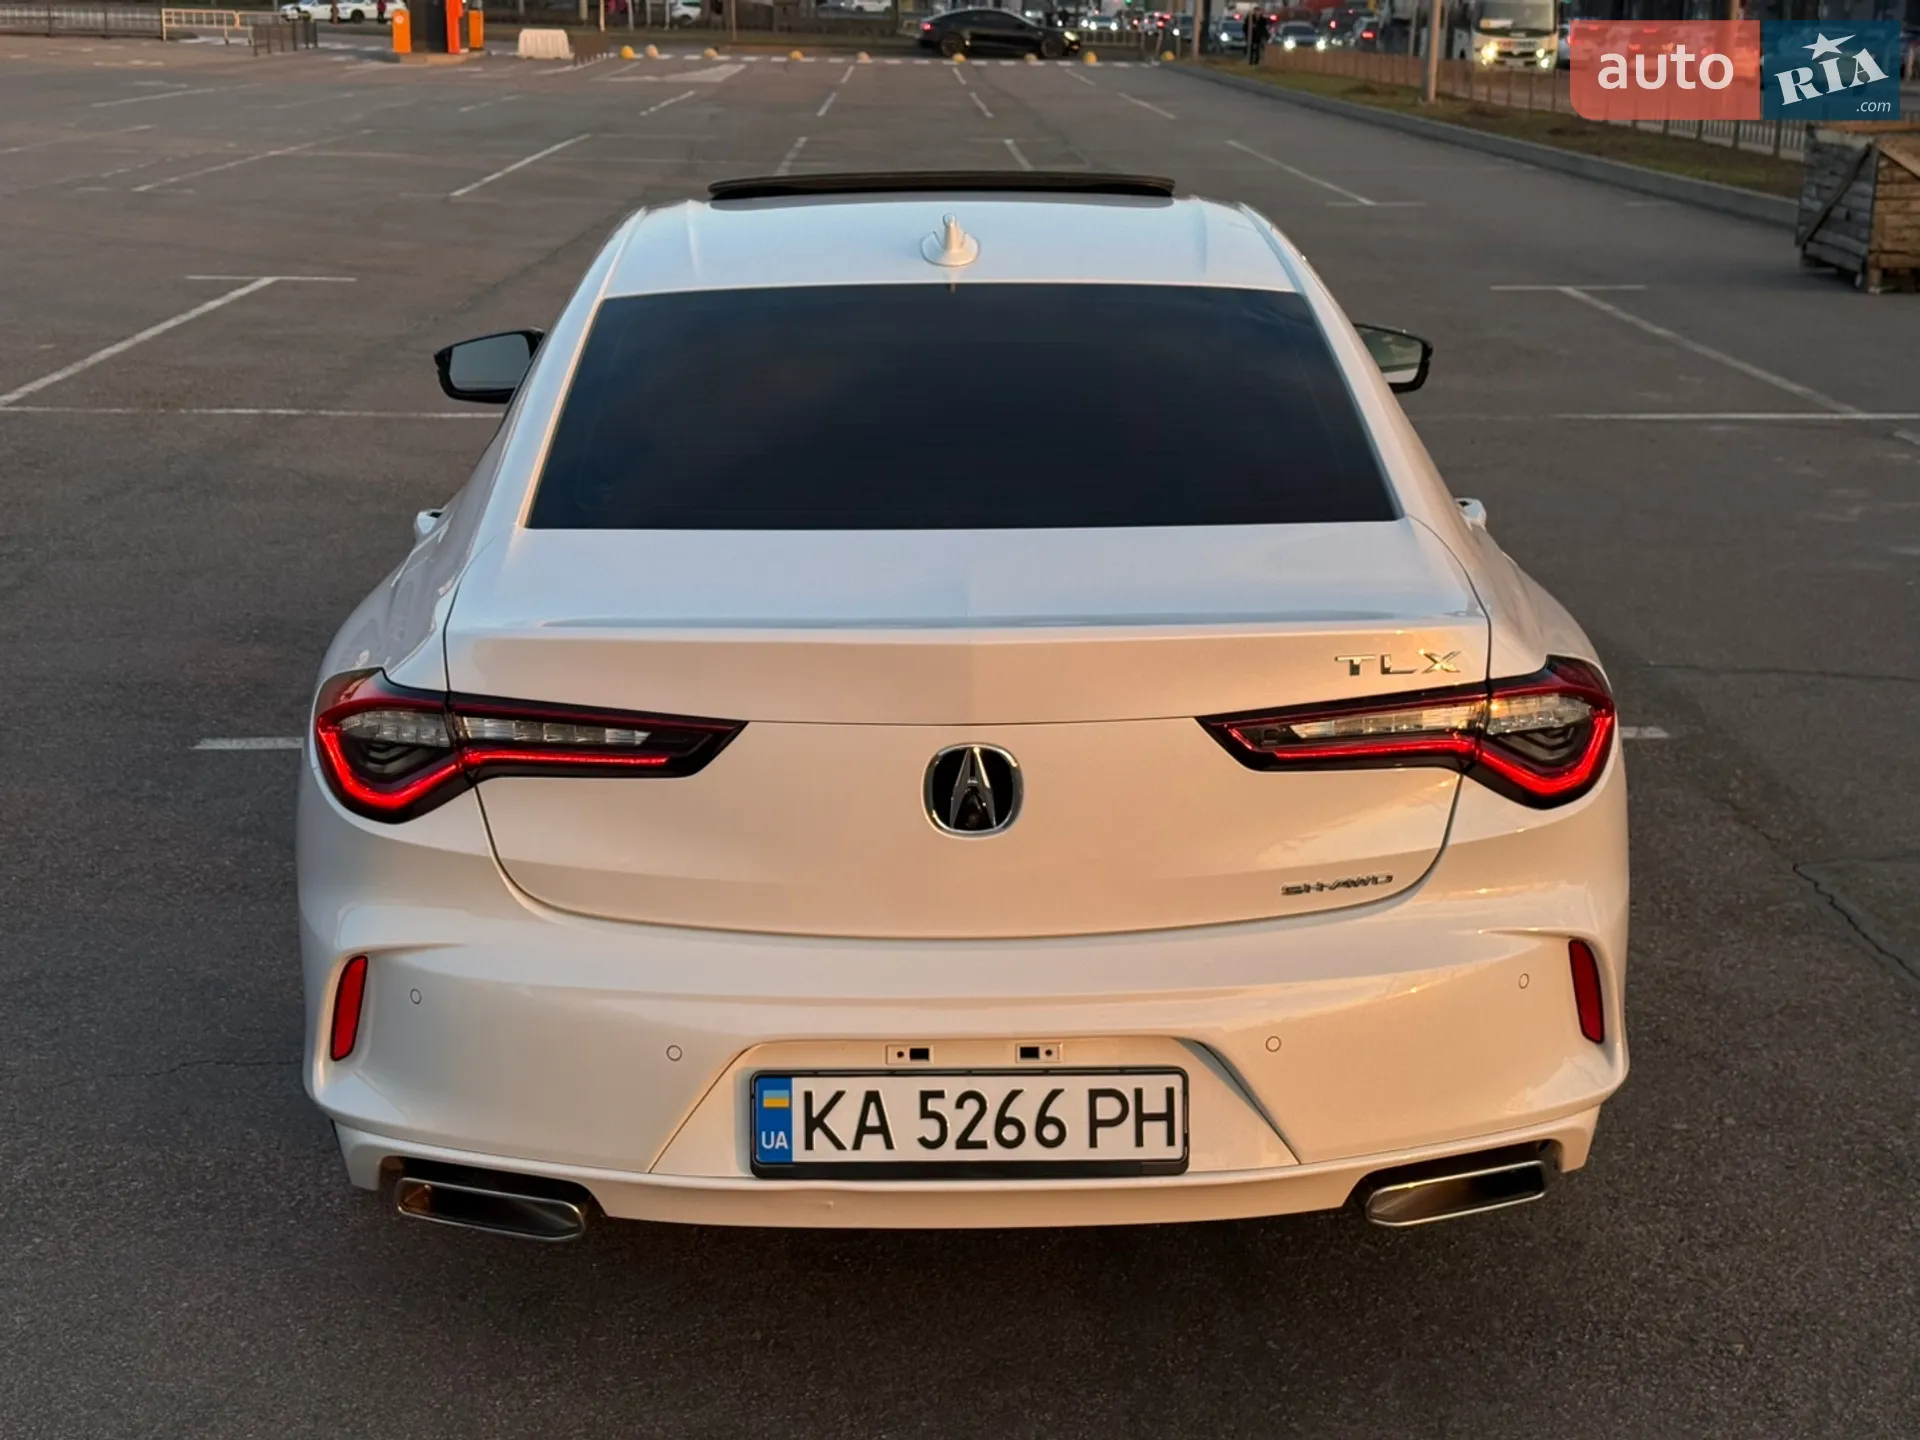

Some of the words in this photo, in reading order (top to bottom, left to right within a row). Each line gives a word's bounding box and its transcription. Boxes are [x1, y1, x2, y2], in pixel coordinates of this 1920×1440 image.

[1335, 651, 1462, 676] TLX
[803, 1089, 895, 1151] KA
[916, 1088, 1067, 1151] 5266
[1088, 1086, 1176, 1149] PH
[761, 1130, 789, 1150] UA
